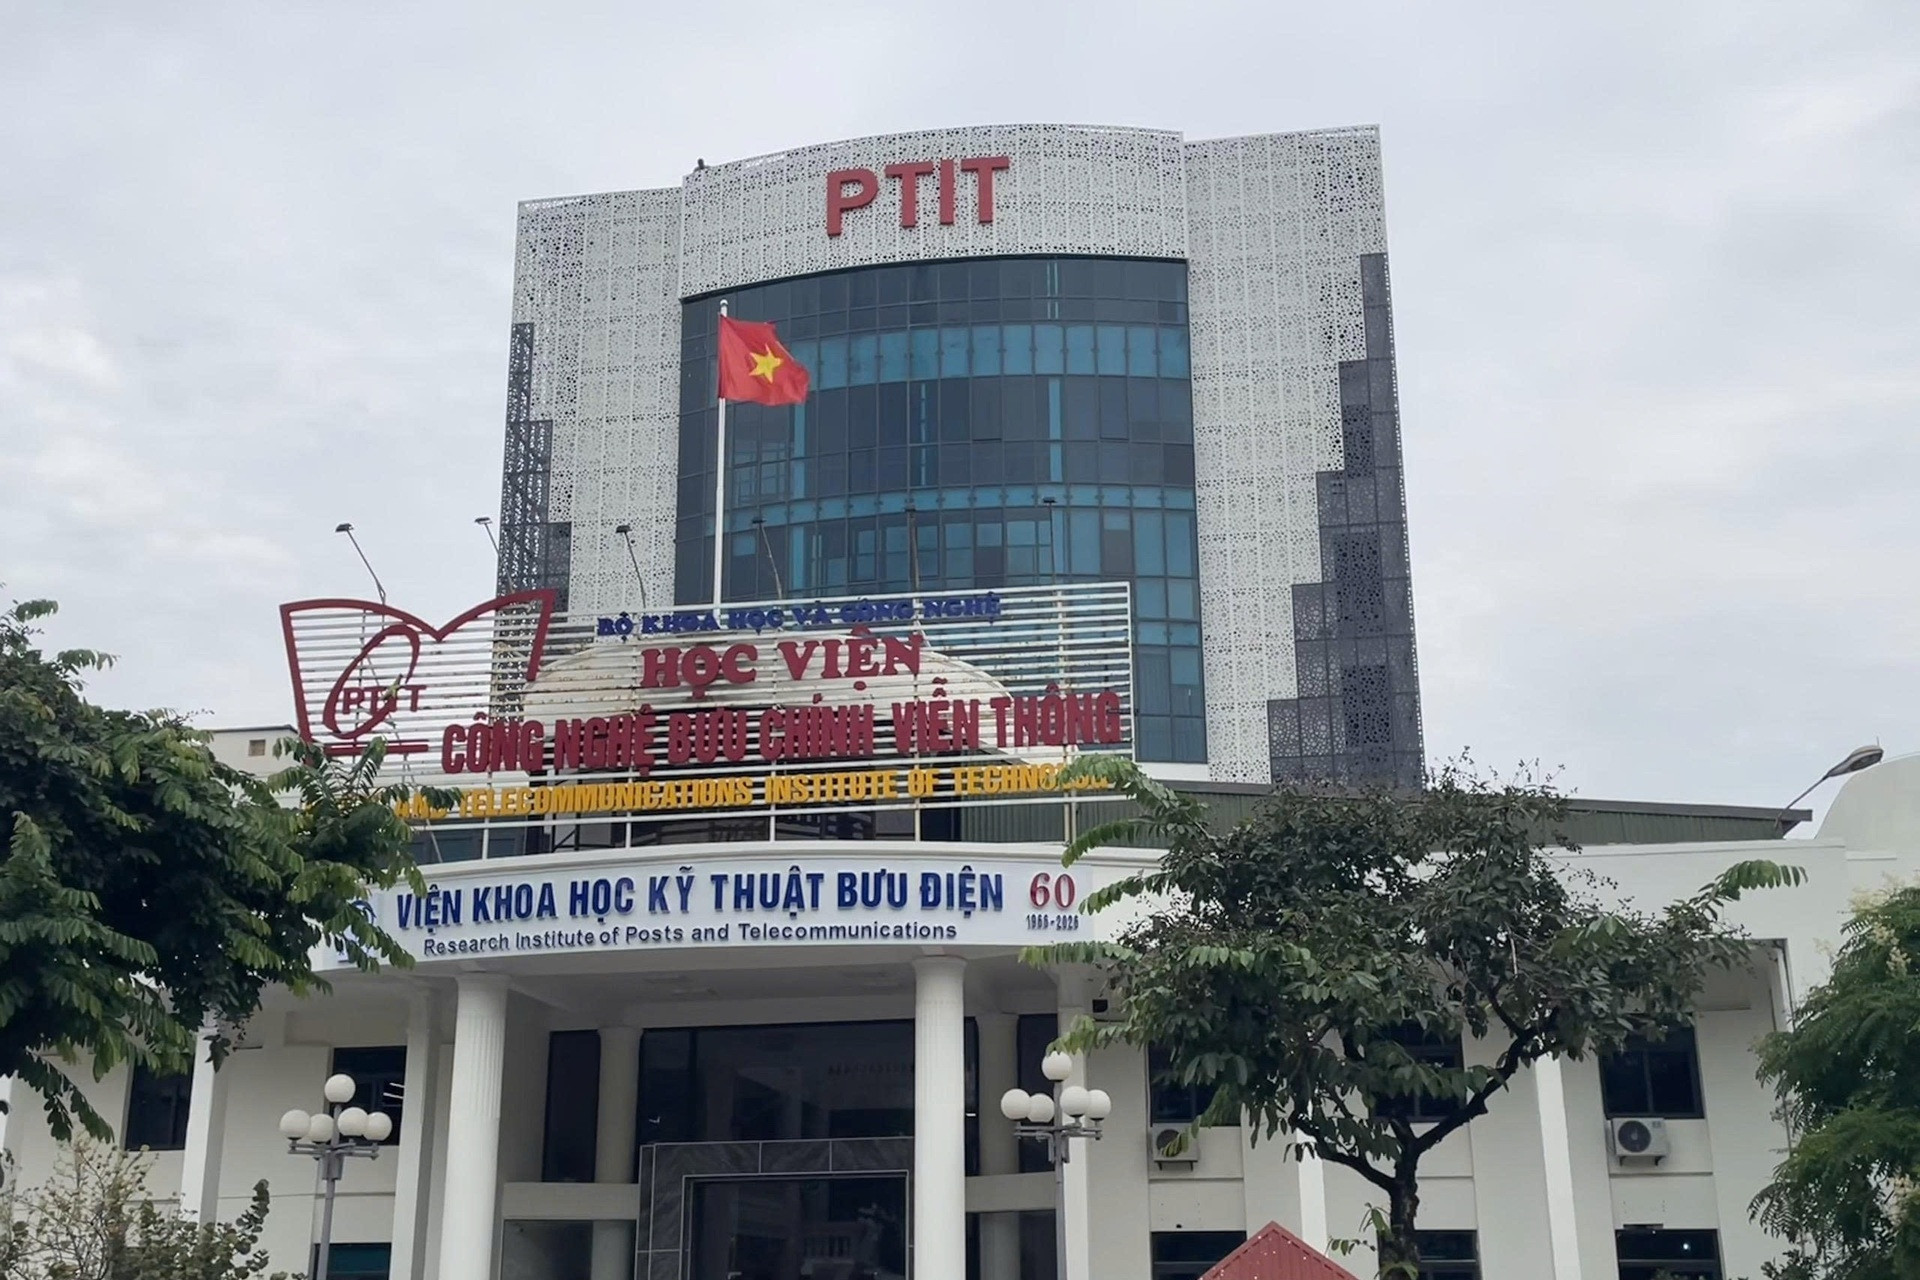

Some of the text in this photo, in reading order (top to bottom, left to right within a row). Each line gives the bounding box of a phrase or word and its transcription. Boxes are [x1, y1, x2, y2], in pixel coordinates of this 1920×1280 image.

[826, 156, 1010, 238] PTIT
[597, 591, 1000, 643] BỘ KHOA HỌC VÀ CÔNG NGHỆ
[640, 624, 924, 699] HỌC VIỆN
[441, 677, 1122, 778] CÔNG NGHỆ BƯU CHÍNH VIỄN THÔNG
[458, 777, 754, 819] TELECOMMUNICATIONS
[764, 769, 897, 804] INSTITUTE
[907, 767, 940, 798] OF
[397, 865, 1004, 934] VIỆN KHOA HỌC KỸ THUẬT BƯU ĐIỆN
[1029, 872, 1076, 909] 60
[424, 920, 958, 956] Research Institute of Posts and Telecommunications
